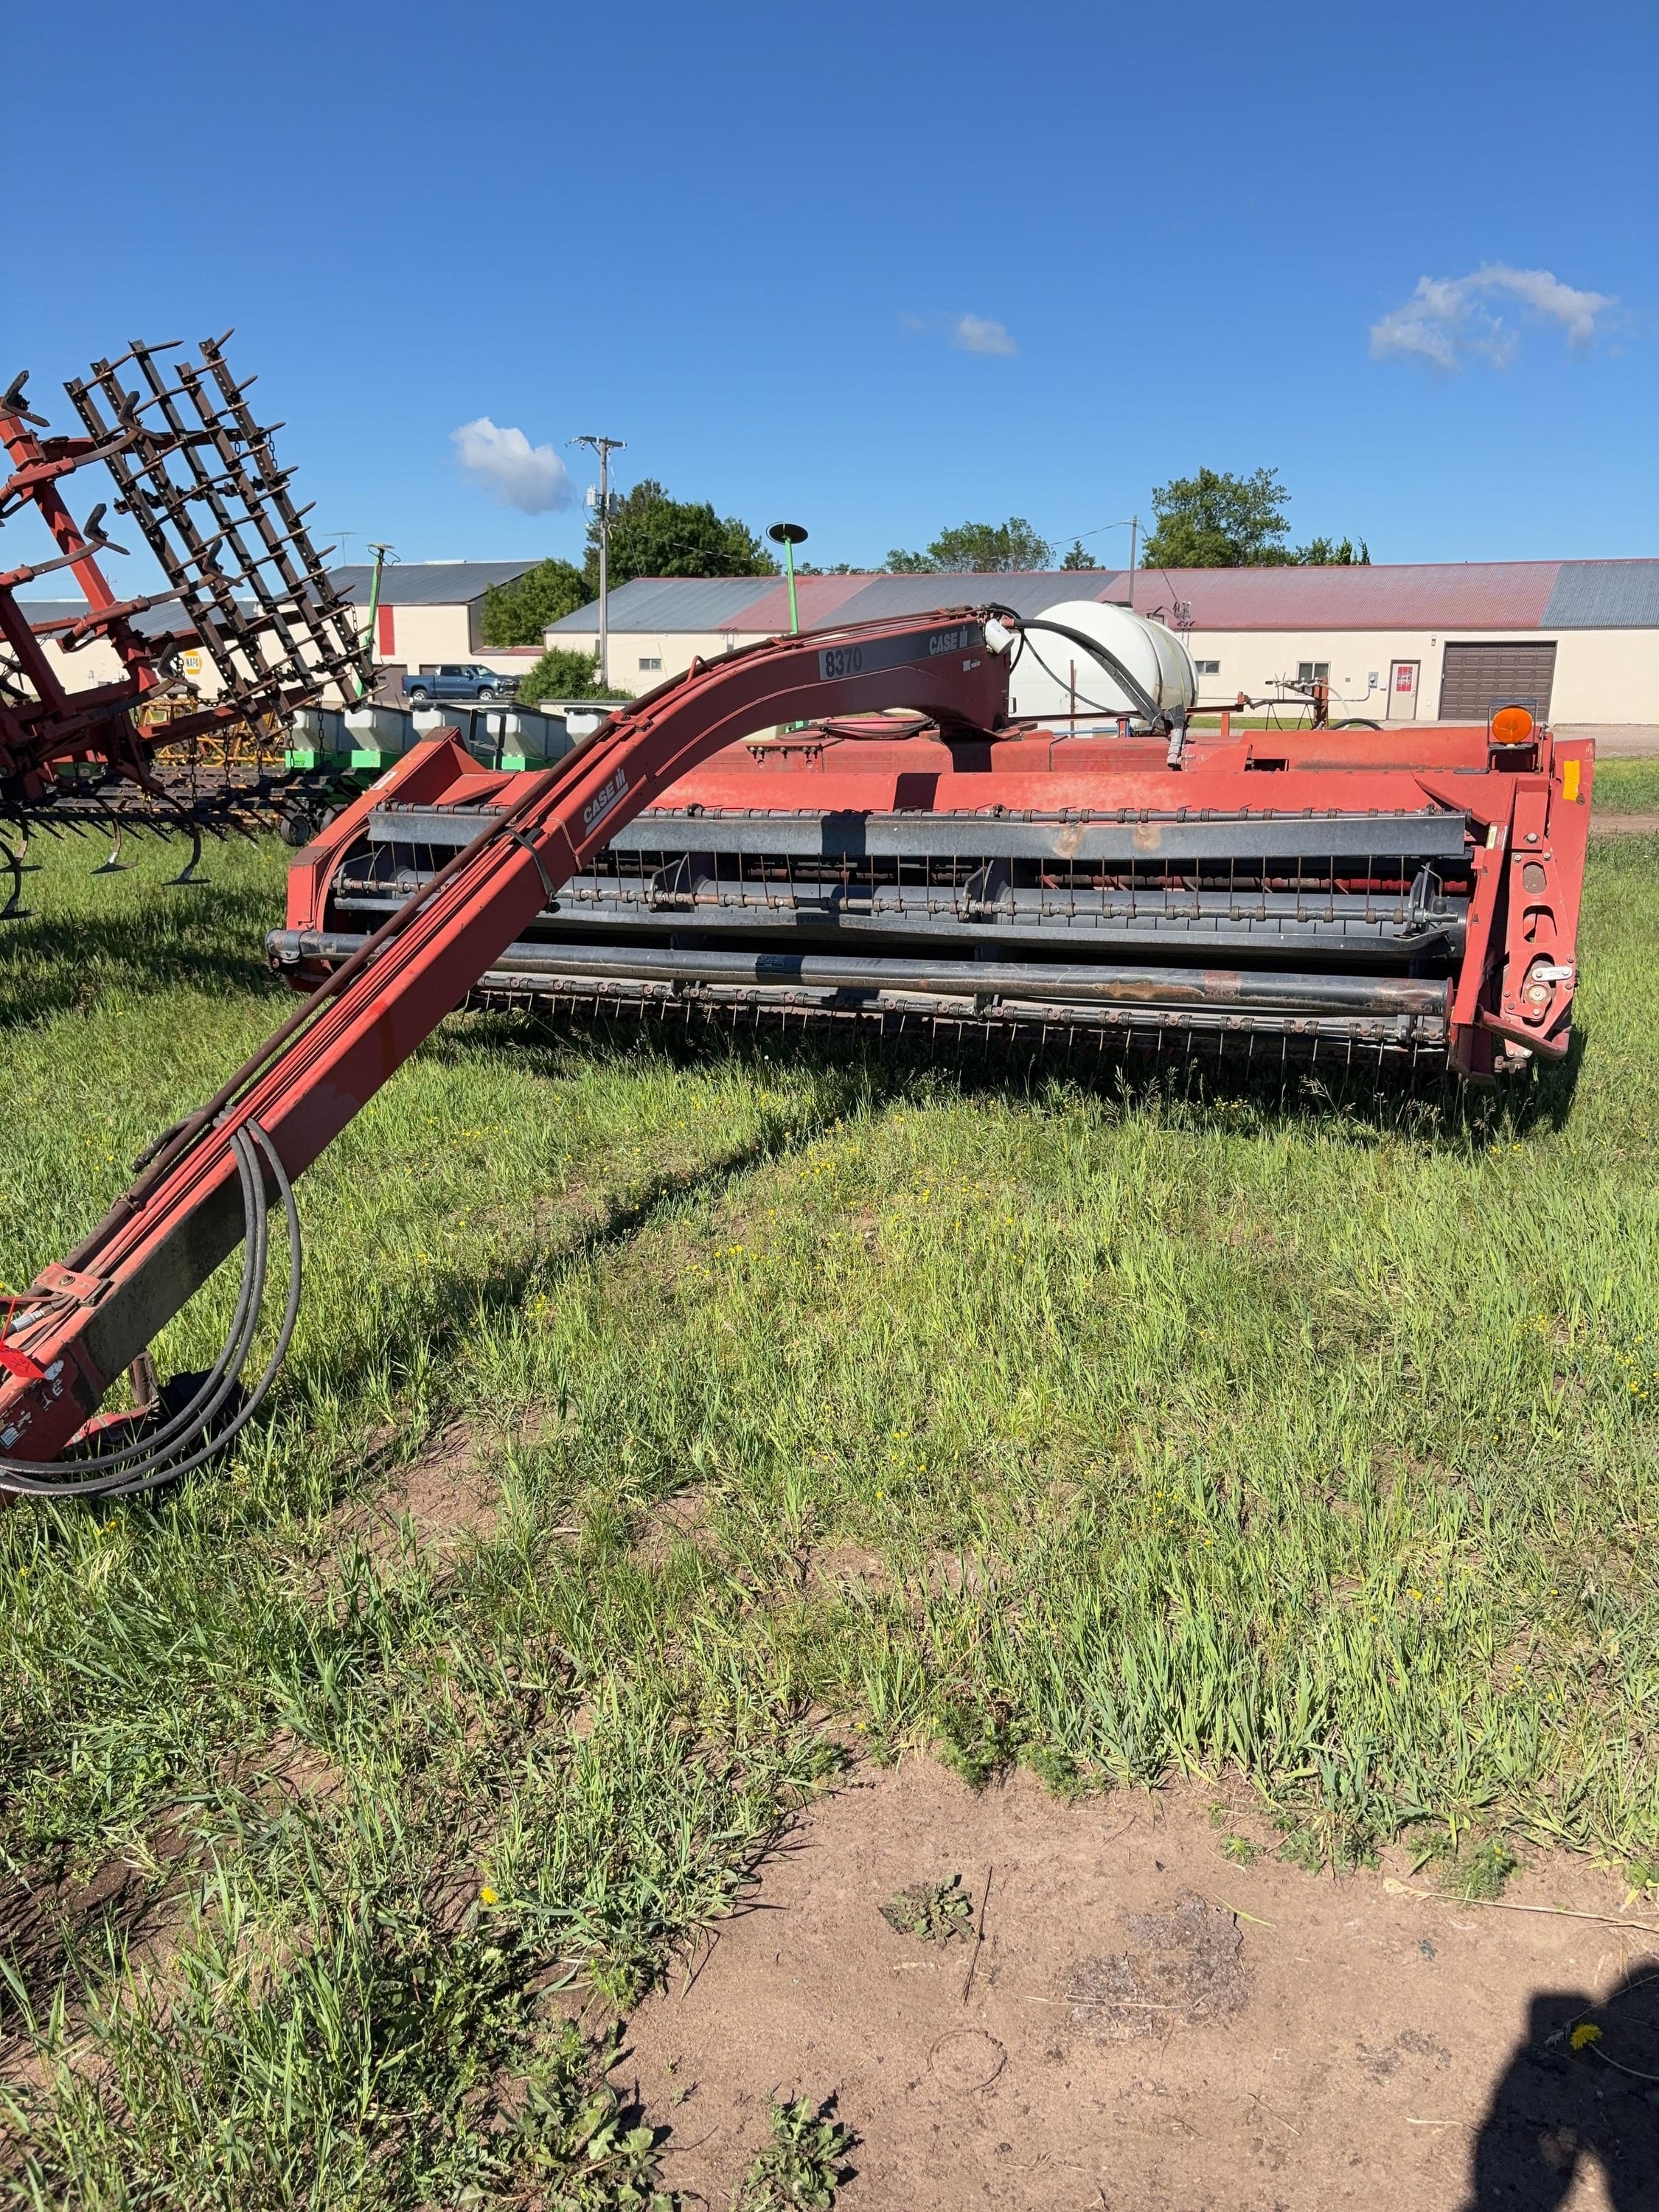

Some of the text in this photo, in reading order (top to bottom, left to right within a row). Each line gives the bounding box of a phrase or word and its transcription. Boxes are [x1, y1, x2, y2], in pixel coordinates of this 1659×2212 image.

[929, 632, 958, 655] CASE
[826, 646, 863, 678] 8370
[583, 780, 615, 824] CASE
